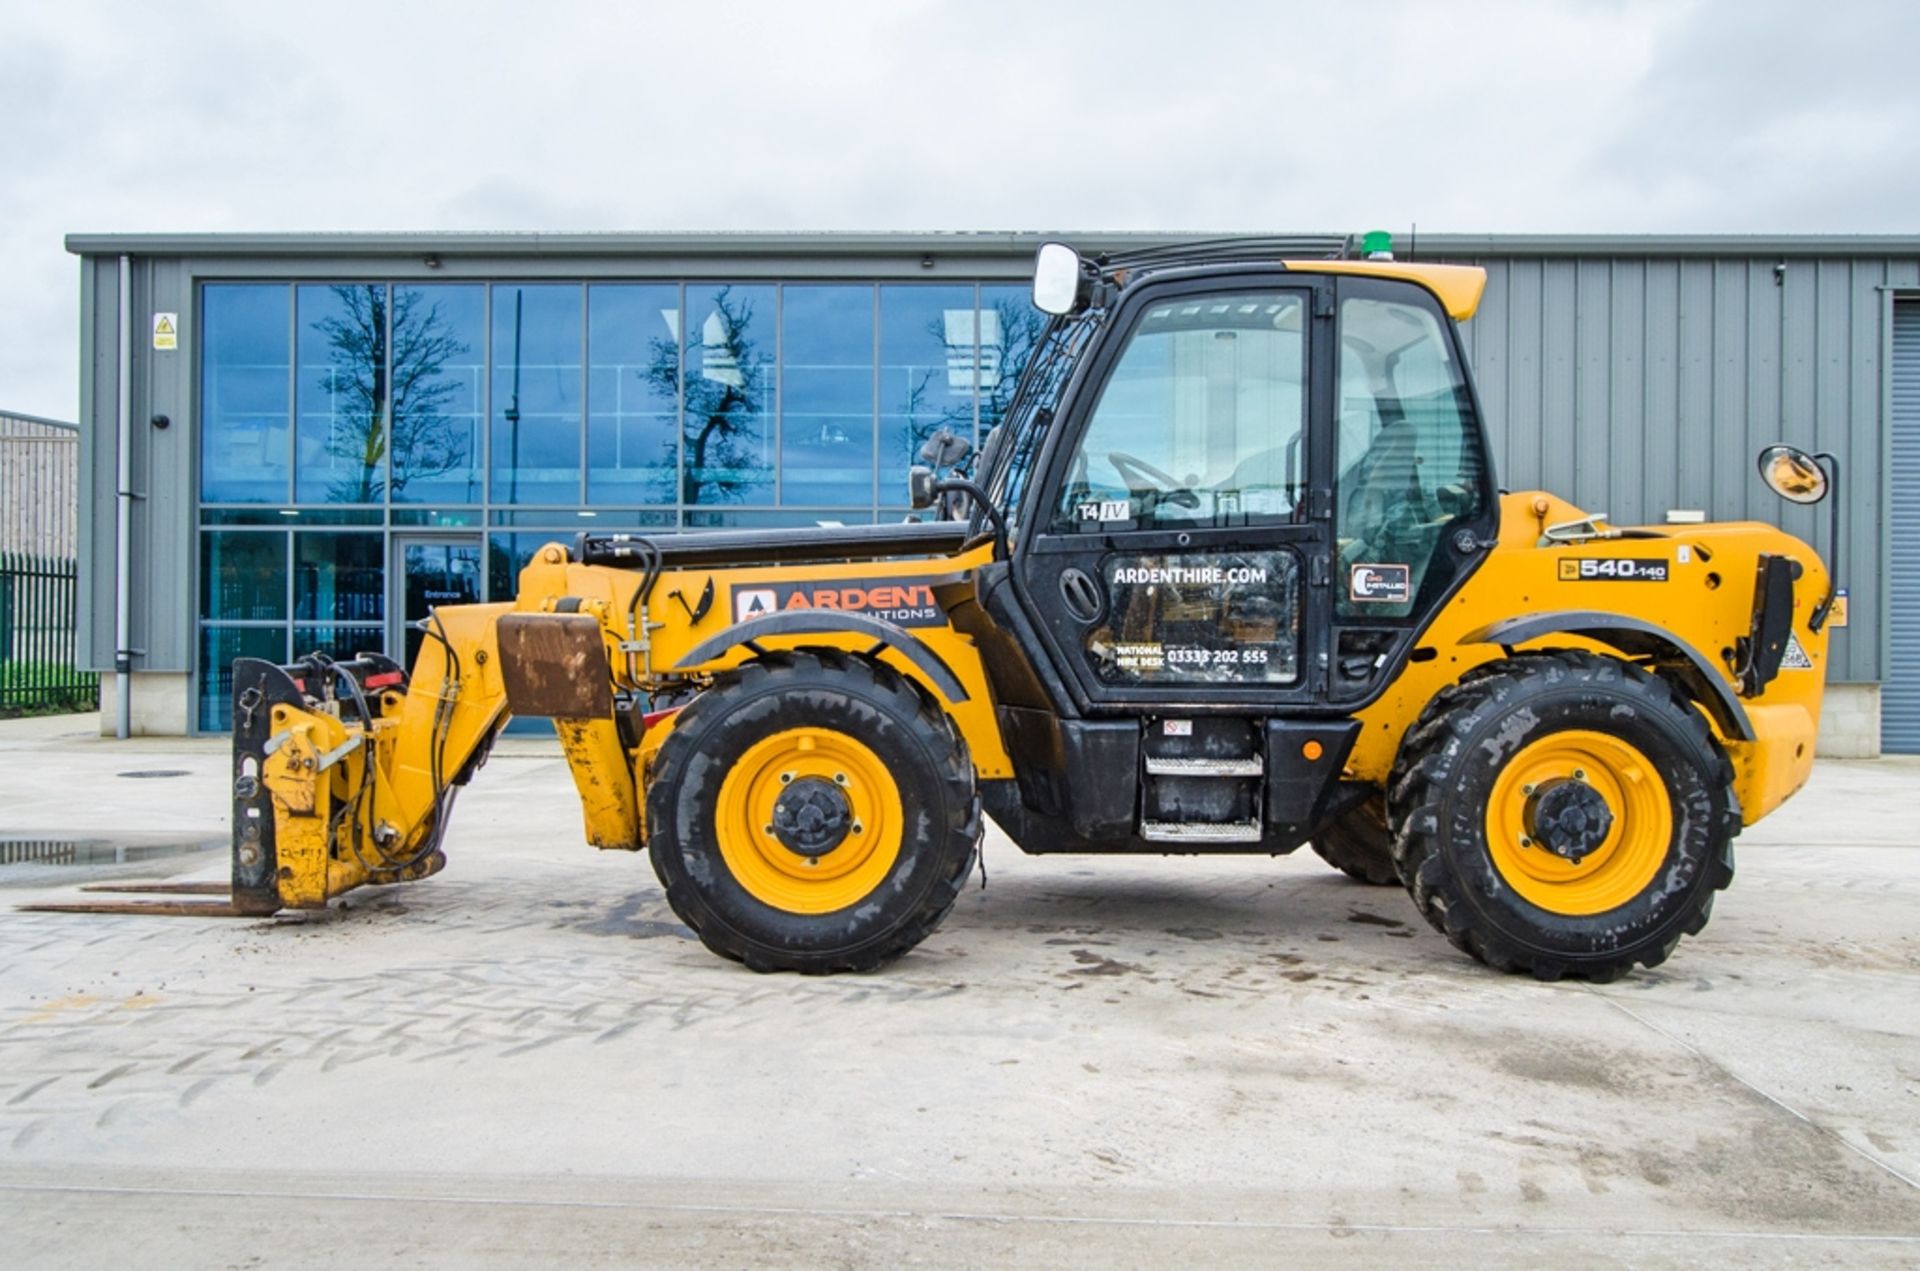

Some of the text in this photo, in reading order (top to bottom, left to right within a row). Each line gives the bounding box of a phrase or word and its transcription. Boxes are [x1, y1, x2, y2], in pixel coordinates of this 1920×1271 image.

[1580, 559, 1666, 576] 540-140
[1113, 567, 1268, 584] ARDENTHIRE.COM
[785, 585, 935, 611] ARDENT
[866, 608, 936, 620] UTIONS
[1116, 645, 1164, 656] NATIONAL
[1167, 649, 1268, 663] 03333 202 555
